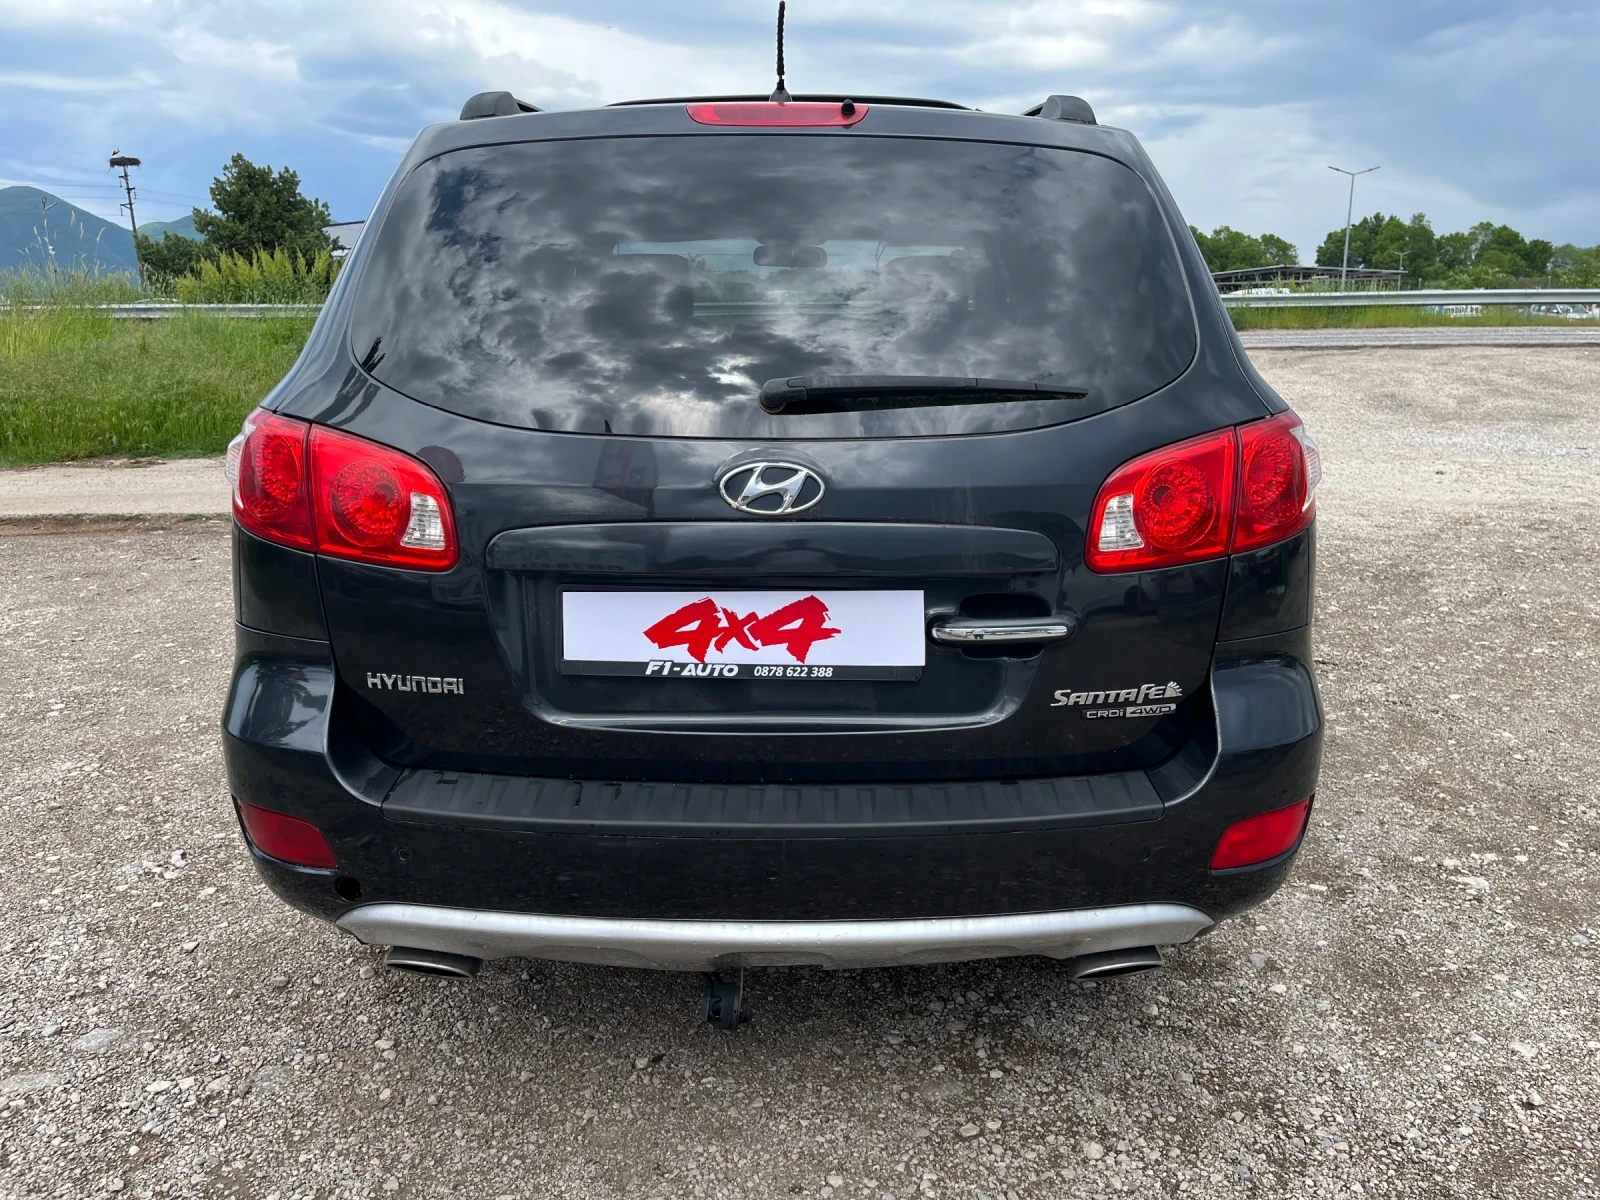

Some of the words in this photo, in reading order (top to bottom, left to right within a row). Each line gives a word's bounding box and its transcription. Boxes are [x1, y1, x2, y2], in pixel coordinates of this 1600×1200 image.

[645, 661, 739, 677] F1-AUTO
[754, 666, 783, 677] 0878
[786, 667, 807, 677] 622
[810, 667, 833, 677] 388
[366, 672, 464, 694] HYUNDAI
[1129, 705, 1172, 716] 4WD
